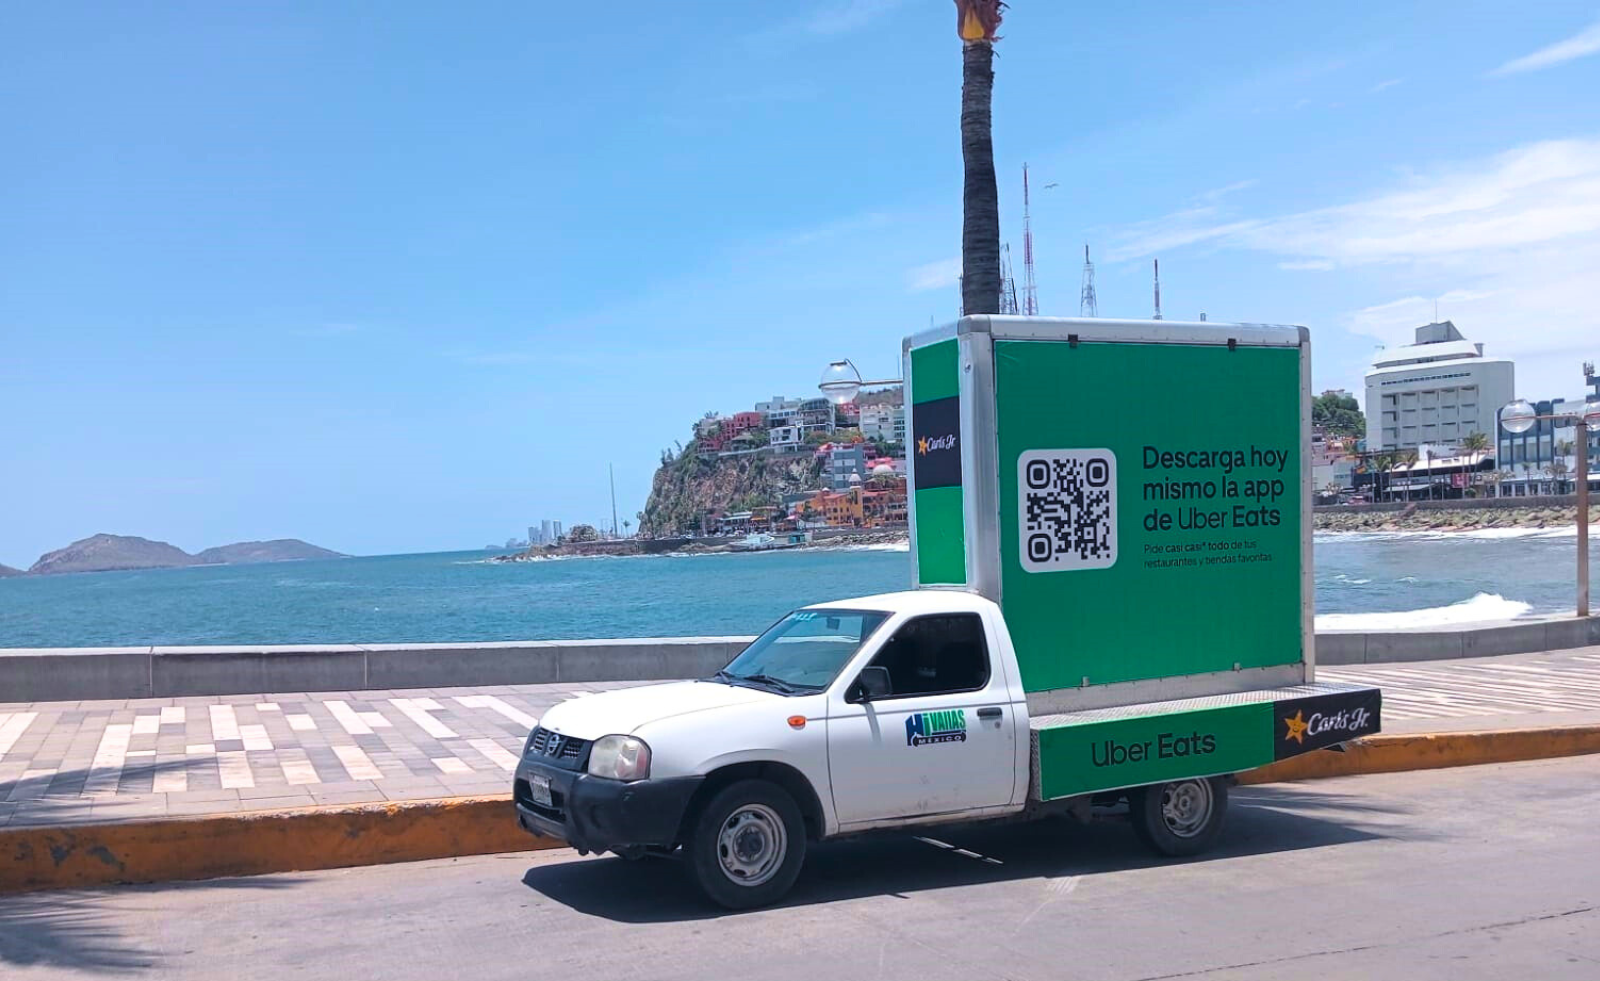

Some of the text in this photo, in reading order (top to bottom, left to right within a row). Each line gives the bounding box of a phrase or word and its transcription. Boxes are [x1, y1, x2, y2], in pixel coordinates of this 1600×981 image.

[1142, 445, 1288, 474] Descarga hoy
[1143, 475, 1284, 503] mismo la app
[1143, 505, 1281, 531] de Uber Eats
[1144, 544, 1164, 554] Pide
[1165, 542, 1184, 553] casi
[1208, 540, 1230, 552] todo
[1231, 540, 1243, 550] de
[1244, 540, 1257, 549] tus
[1144, 557, 1197, 569] restaurantes
[1205, 554, 1237, 565] tiendas
[1238, 553, 1272, 564] favoritas
[1307, 707, 1370, 736] Carl's Jr.
[1091, 731, 1216, 767] Uber Eats
